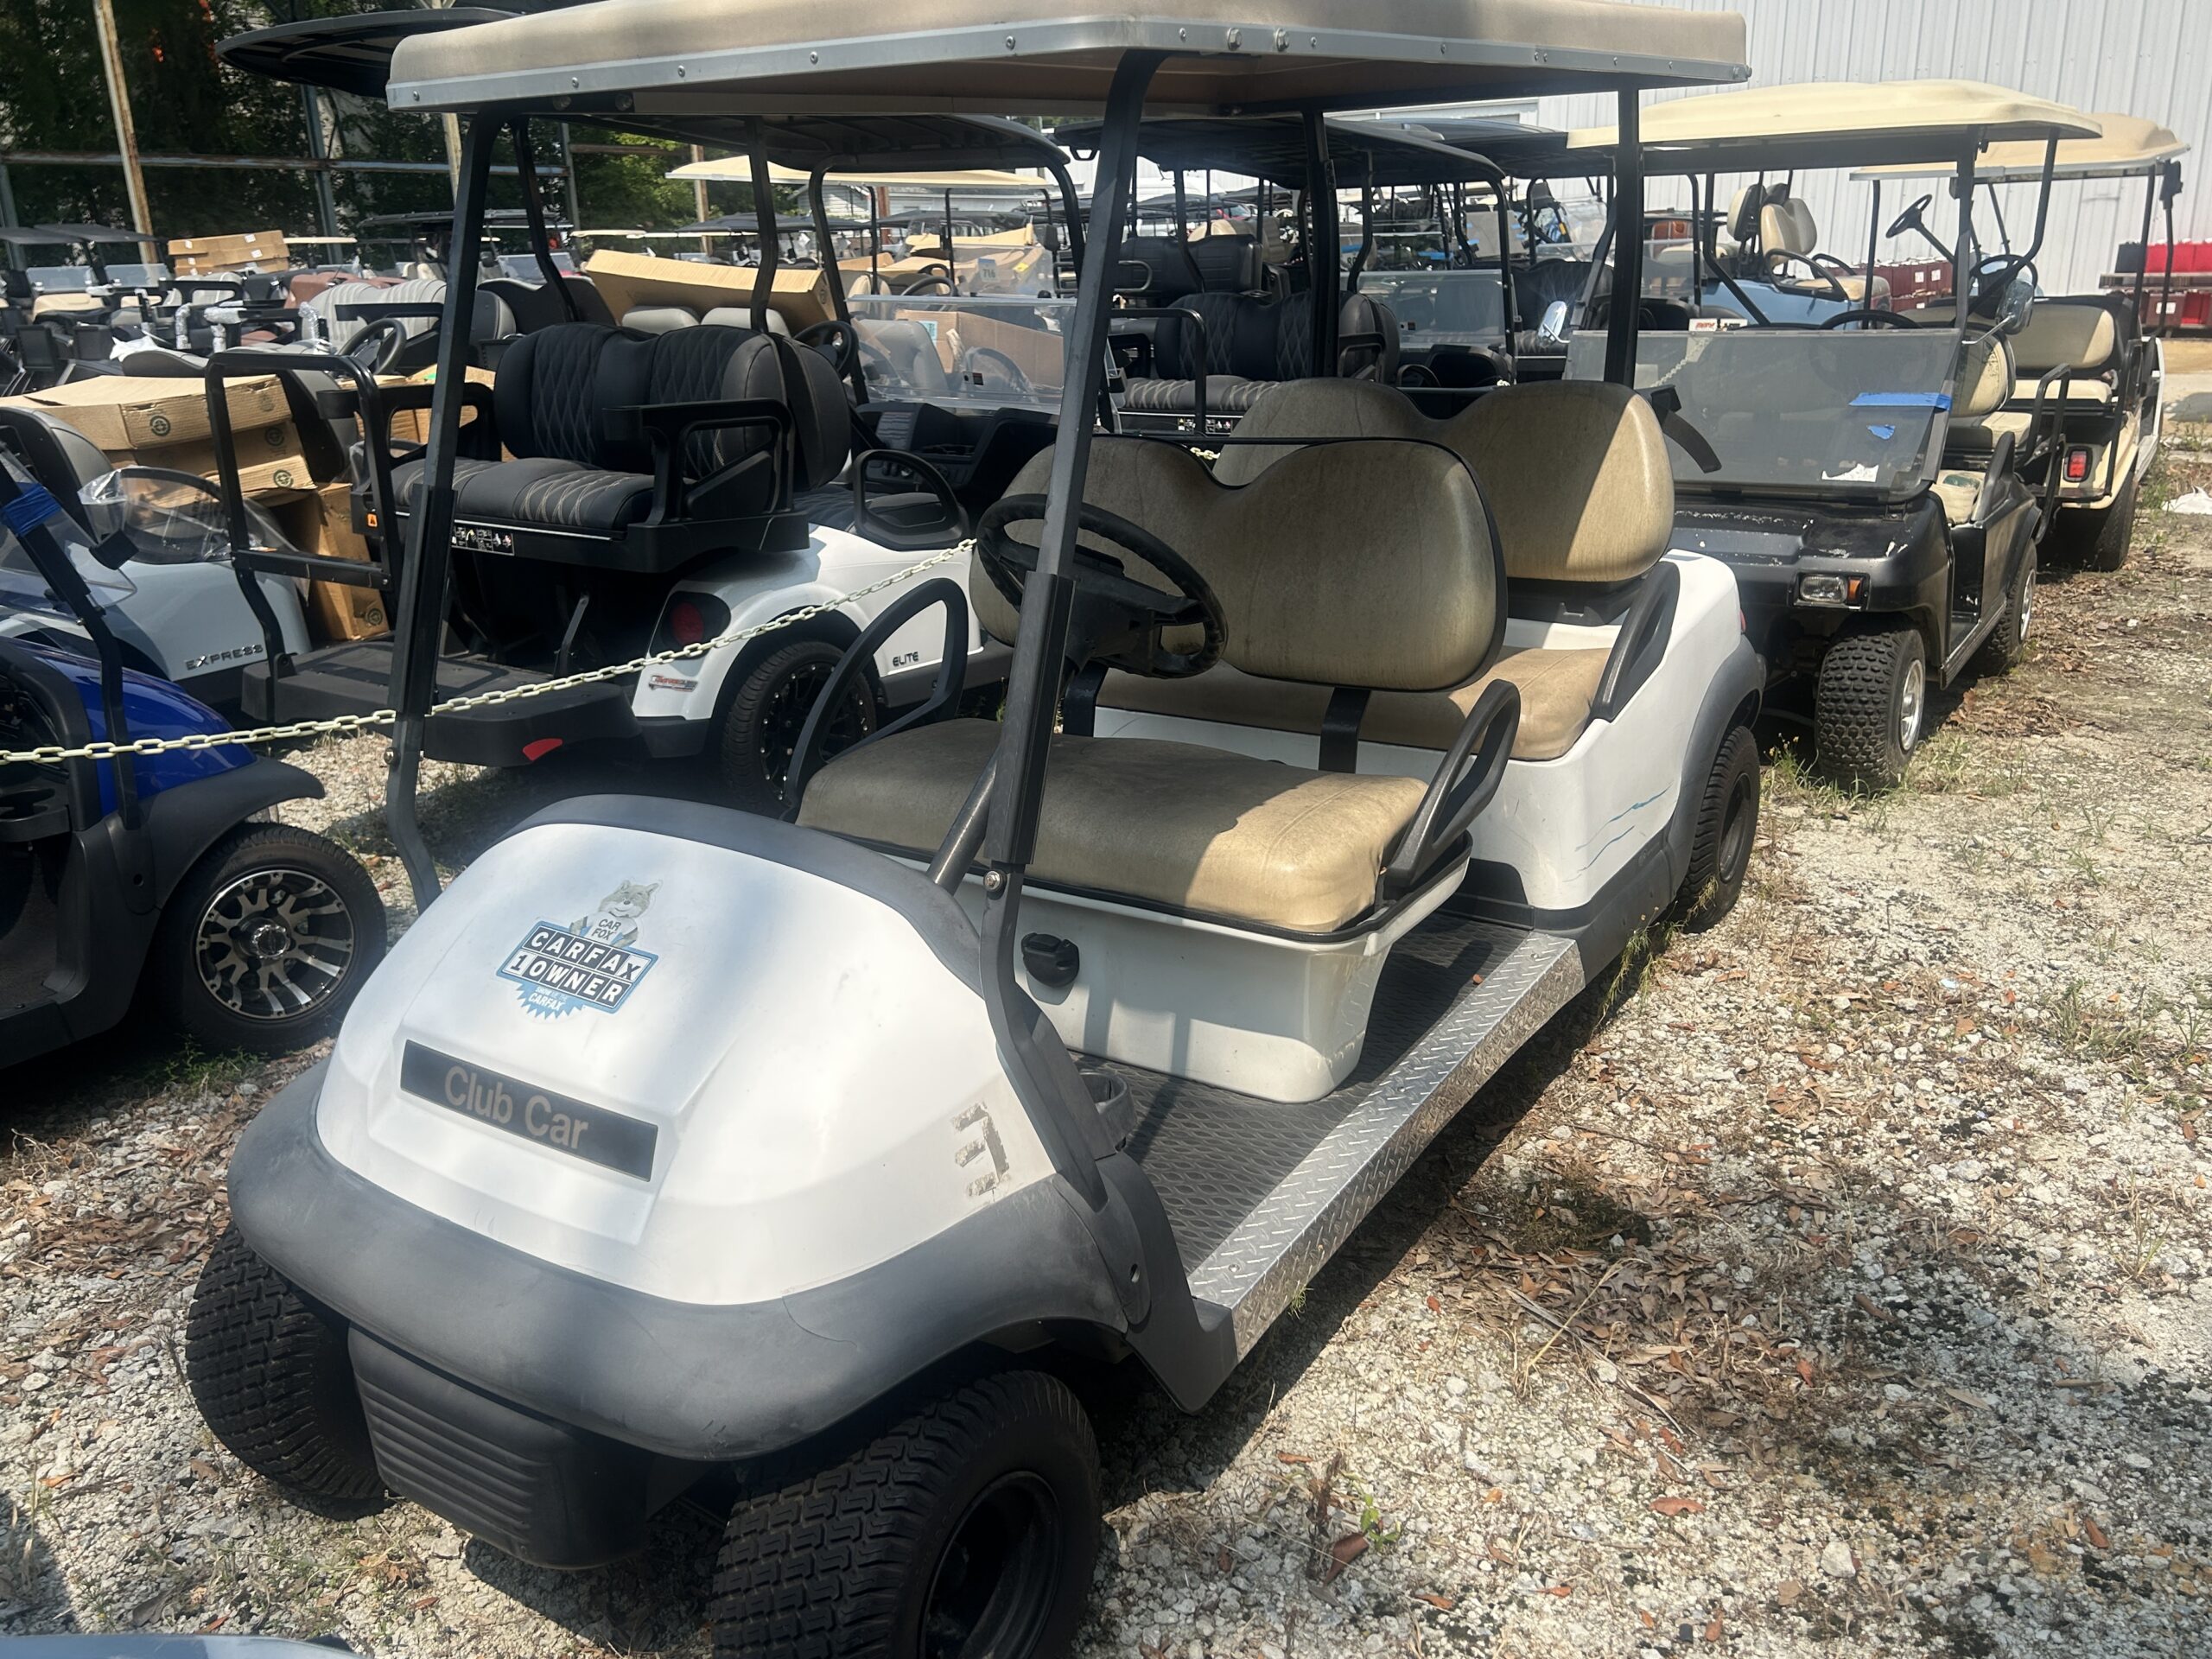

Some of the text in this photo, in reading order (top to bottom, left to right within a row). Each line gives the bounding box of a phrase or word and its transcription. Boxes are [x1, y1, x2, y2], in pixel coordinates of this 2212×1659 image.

[185, 644, 264, 671] EXPRESS
[893, 651, 919, 667] ELITE
[591, 928, 615, 941] FOX
[598, 918, 622, 931] CAR
[531, 931, 641, 981] CARFAX
[510, 953, 528, 972] 1
[528, 960, 623, 1002] OWNER
[528, 992, 565, 1011] CARFAX
[444, 1065, 589, 1150] Club Car
